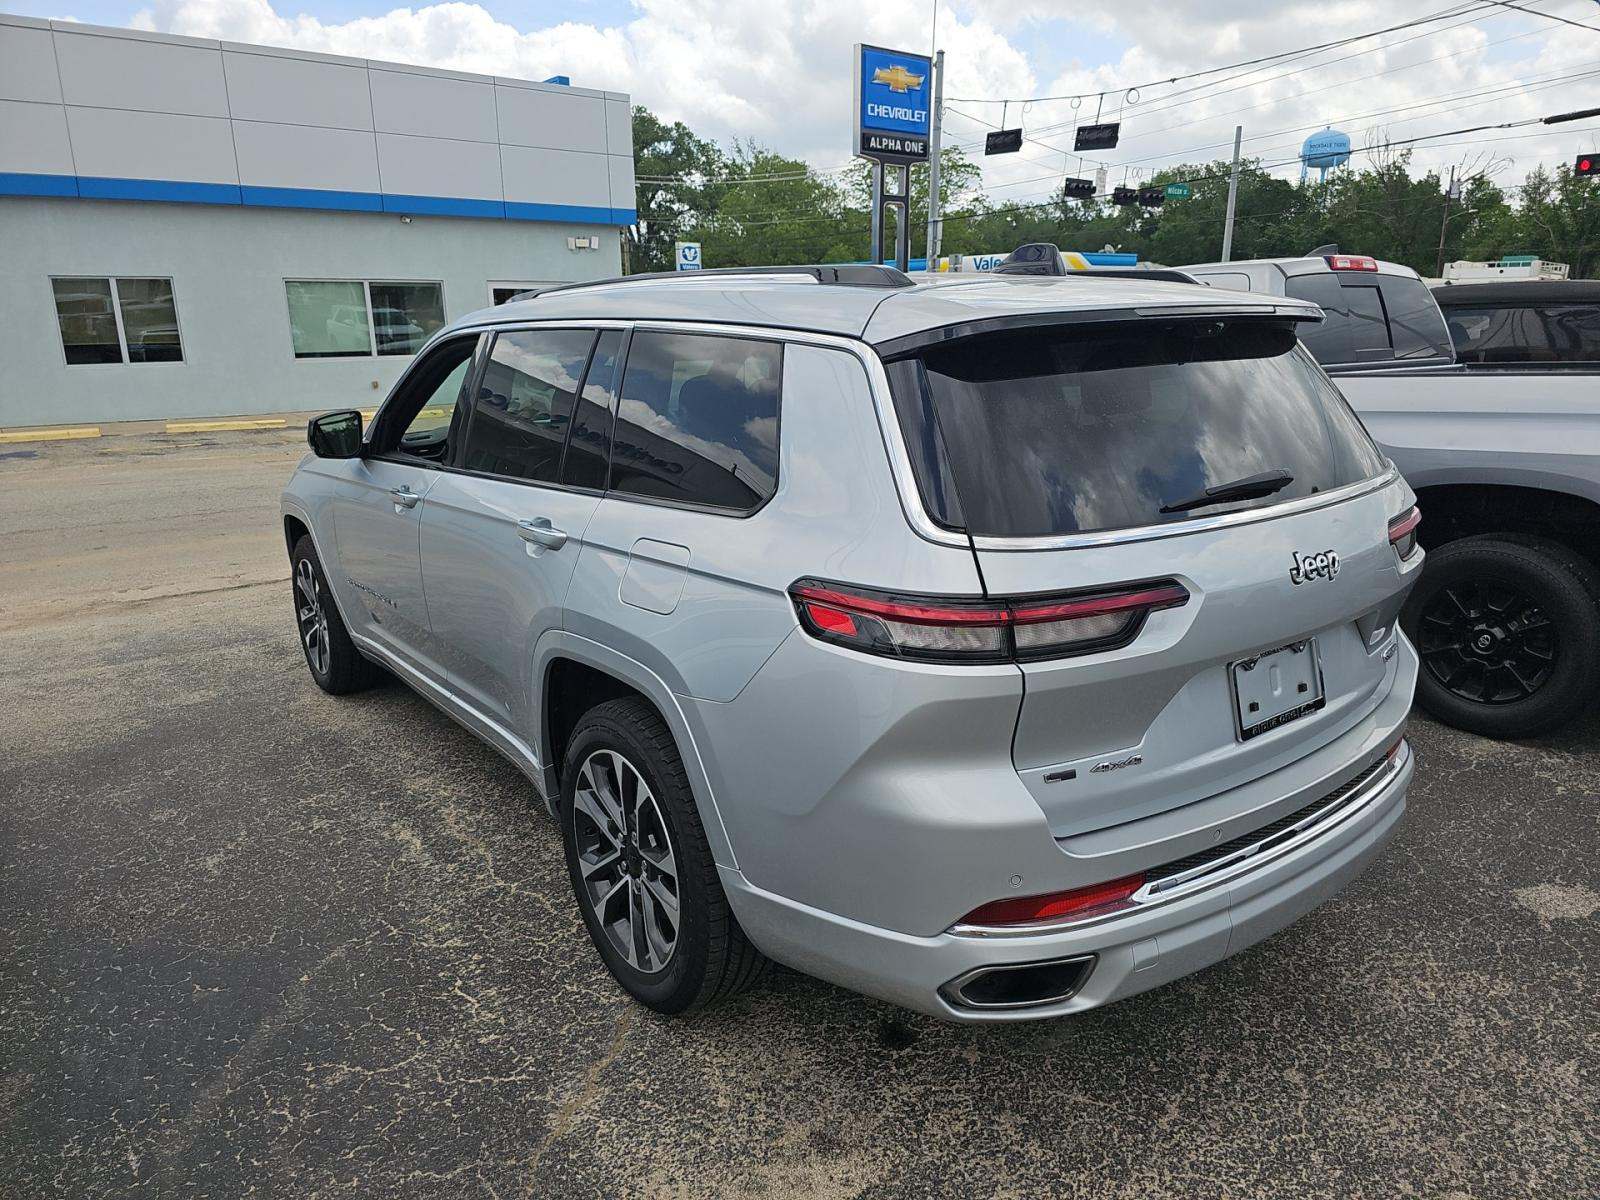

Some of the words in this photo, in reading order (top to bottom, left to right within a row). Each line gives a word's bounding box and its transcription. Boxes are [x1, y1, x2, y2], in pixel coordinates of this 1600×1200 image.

[867, 103, 927, 122] CHEVROLET
[870, 136, 901, 151] ALPHA
[904, 140, 924, 153] ONE
[974, 257, 1003, 270] Vale
[1289, 549, 1340, 585] Jeep
